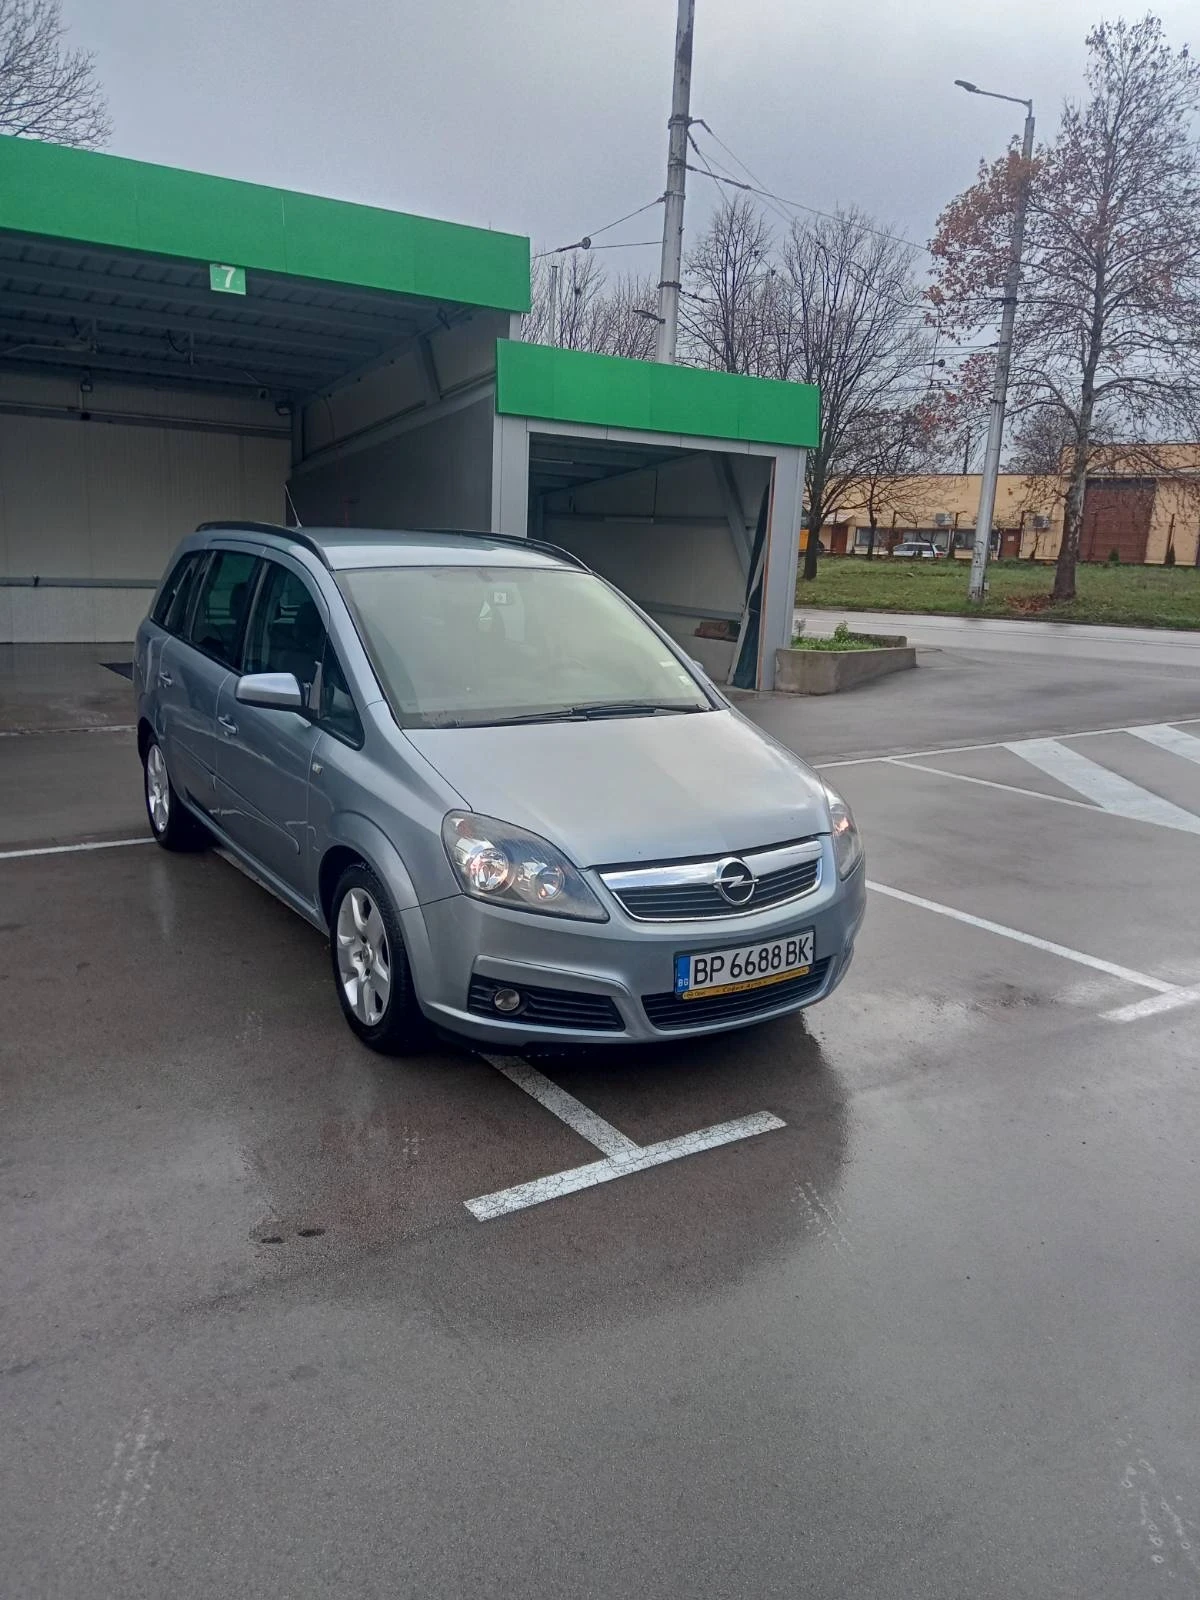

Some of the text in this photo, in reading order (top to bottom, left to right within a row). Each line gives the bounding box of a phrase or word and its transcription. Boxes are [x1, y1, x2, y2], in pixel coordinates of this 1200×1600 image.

[220, 264, 236, 289] 7
[693, 937, 809, 986] BP 6688 BK
[677, 978, 689, 988] BG
